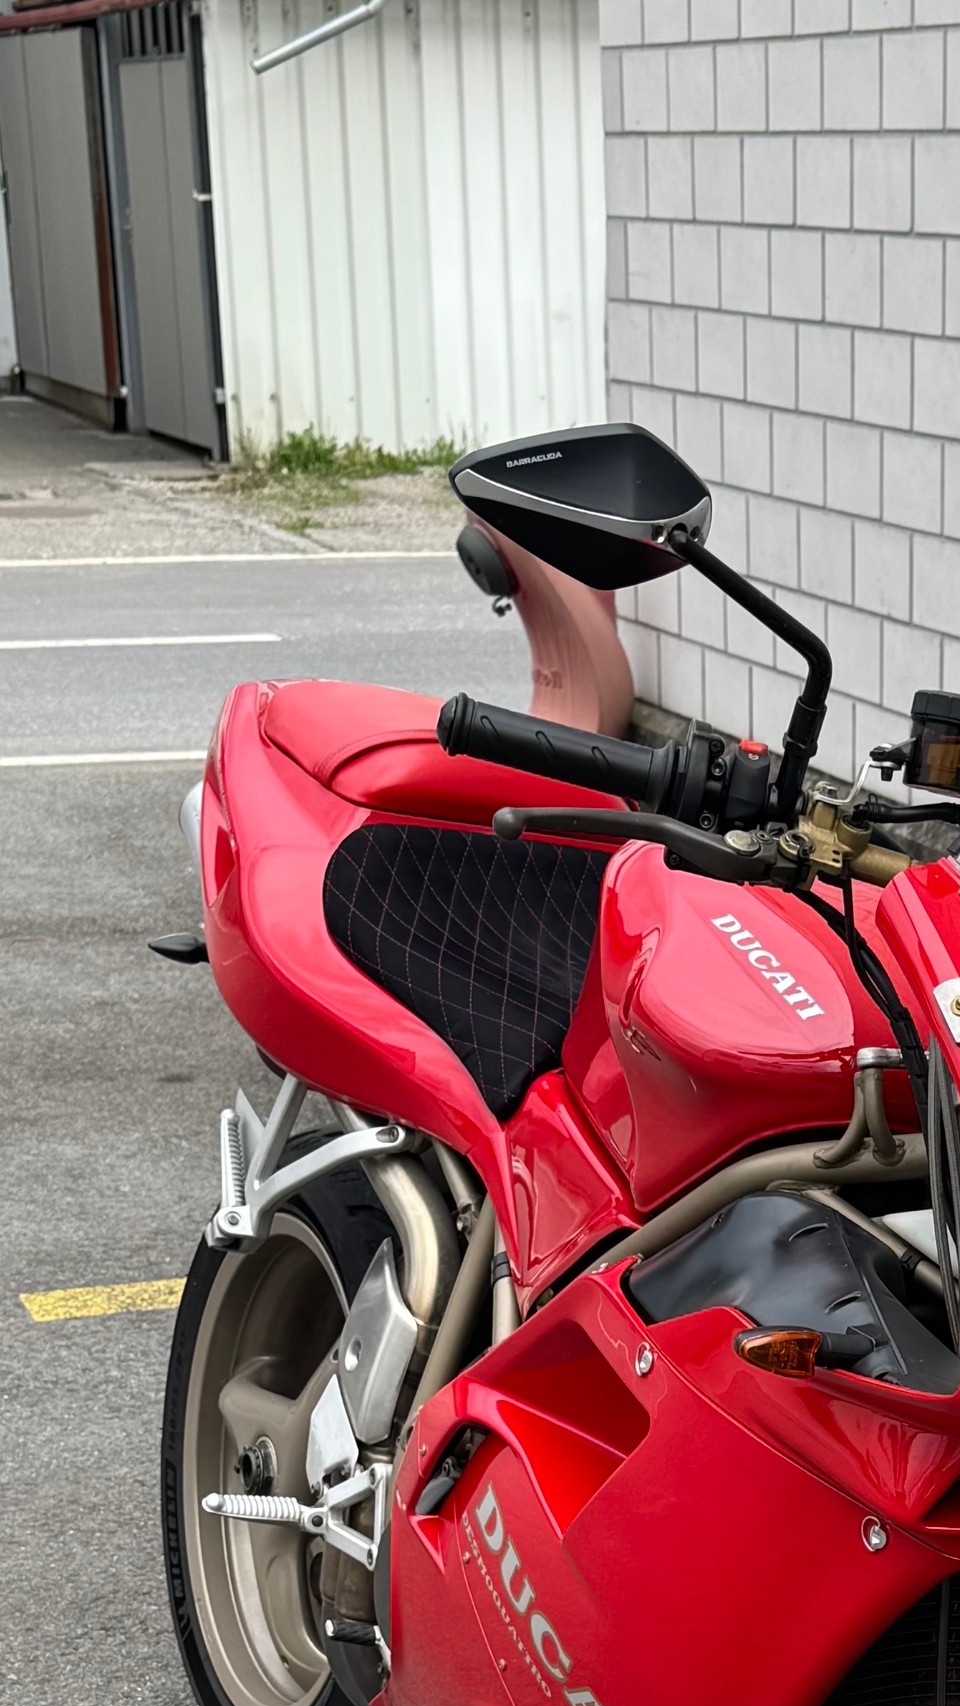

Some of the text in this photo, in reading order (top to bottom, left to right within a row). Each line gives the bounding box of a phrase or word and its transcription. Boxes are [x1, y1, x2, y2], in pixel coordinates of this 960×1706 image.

[506, 451, 563, 468] BARRACUDA
[710, 913, 826, 1021] DUCATI
[165, 1466, 184, 1598] MICHELIN
